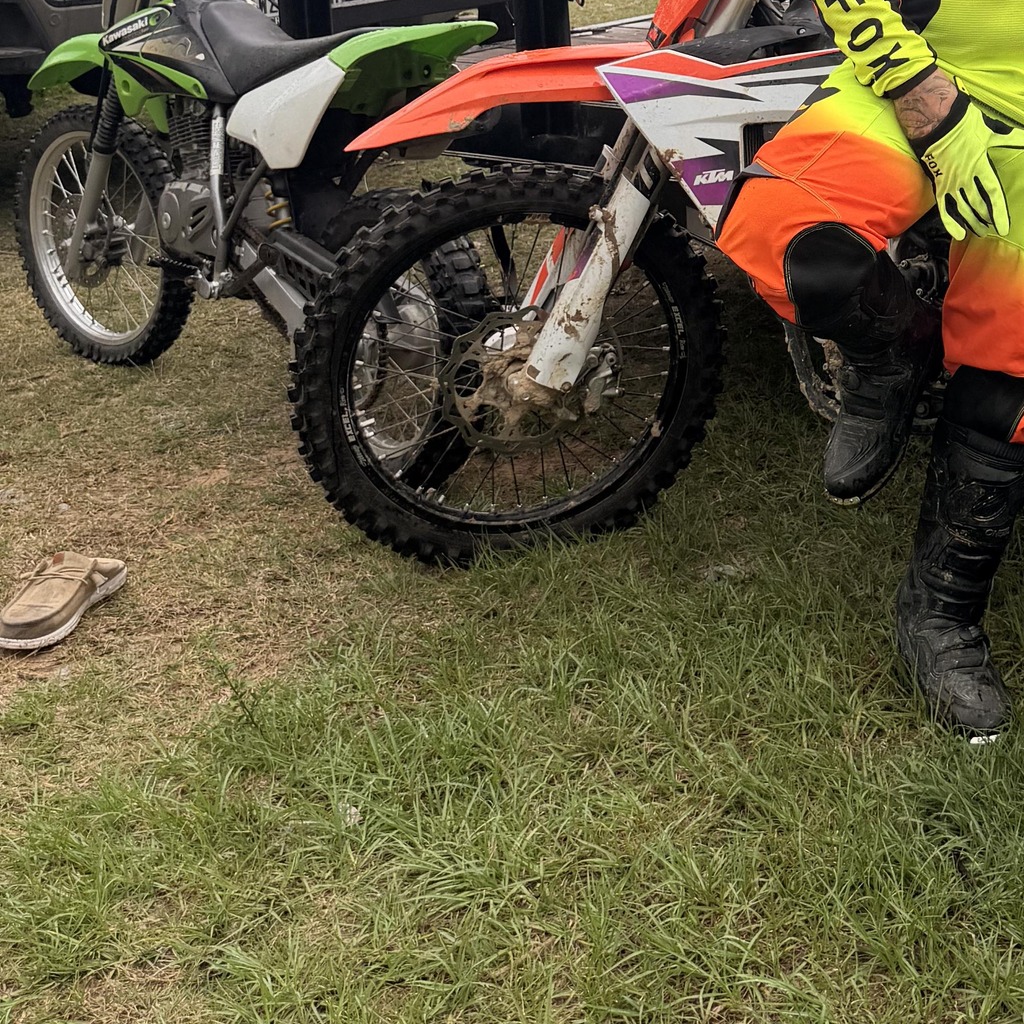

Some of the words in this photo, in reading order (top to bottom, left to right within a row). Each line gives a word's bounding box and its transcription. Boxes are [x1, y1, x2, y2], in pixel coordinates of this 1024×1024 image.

[102, 16, 149, 46] Kawasaki
[693, 168, 735, 186] KTM
[924, 153, 944, 178] FOX
